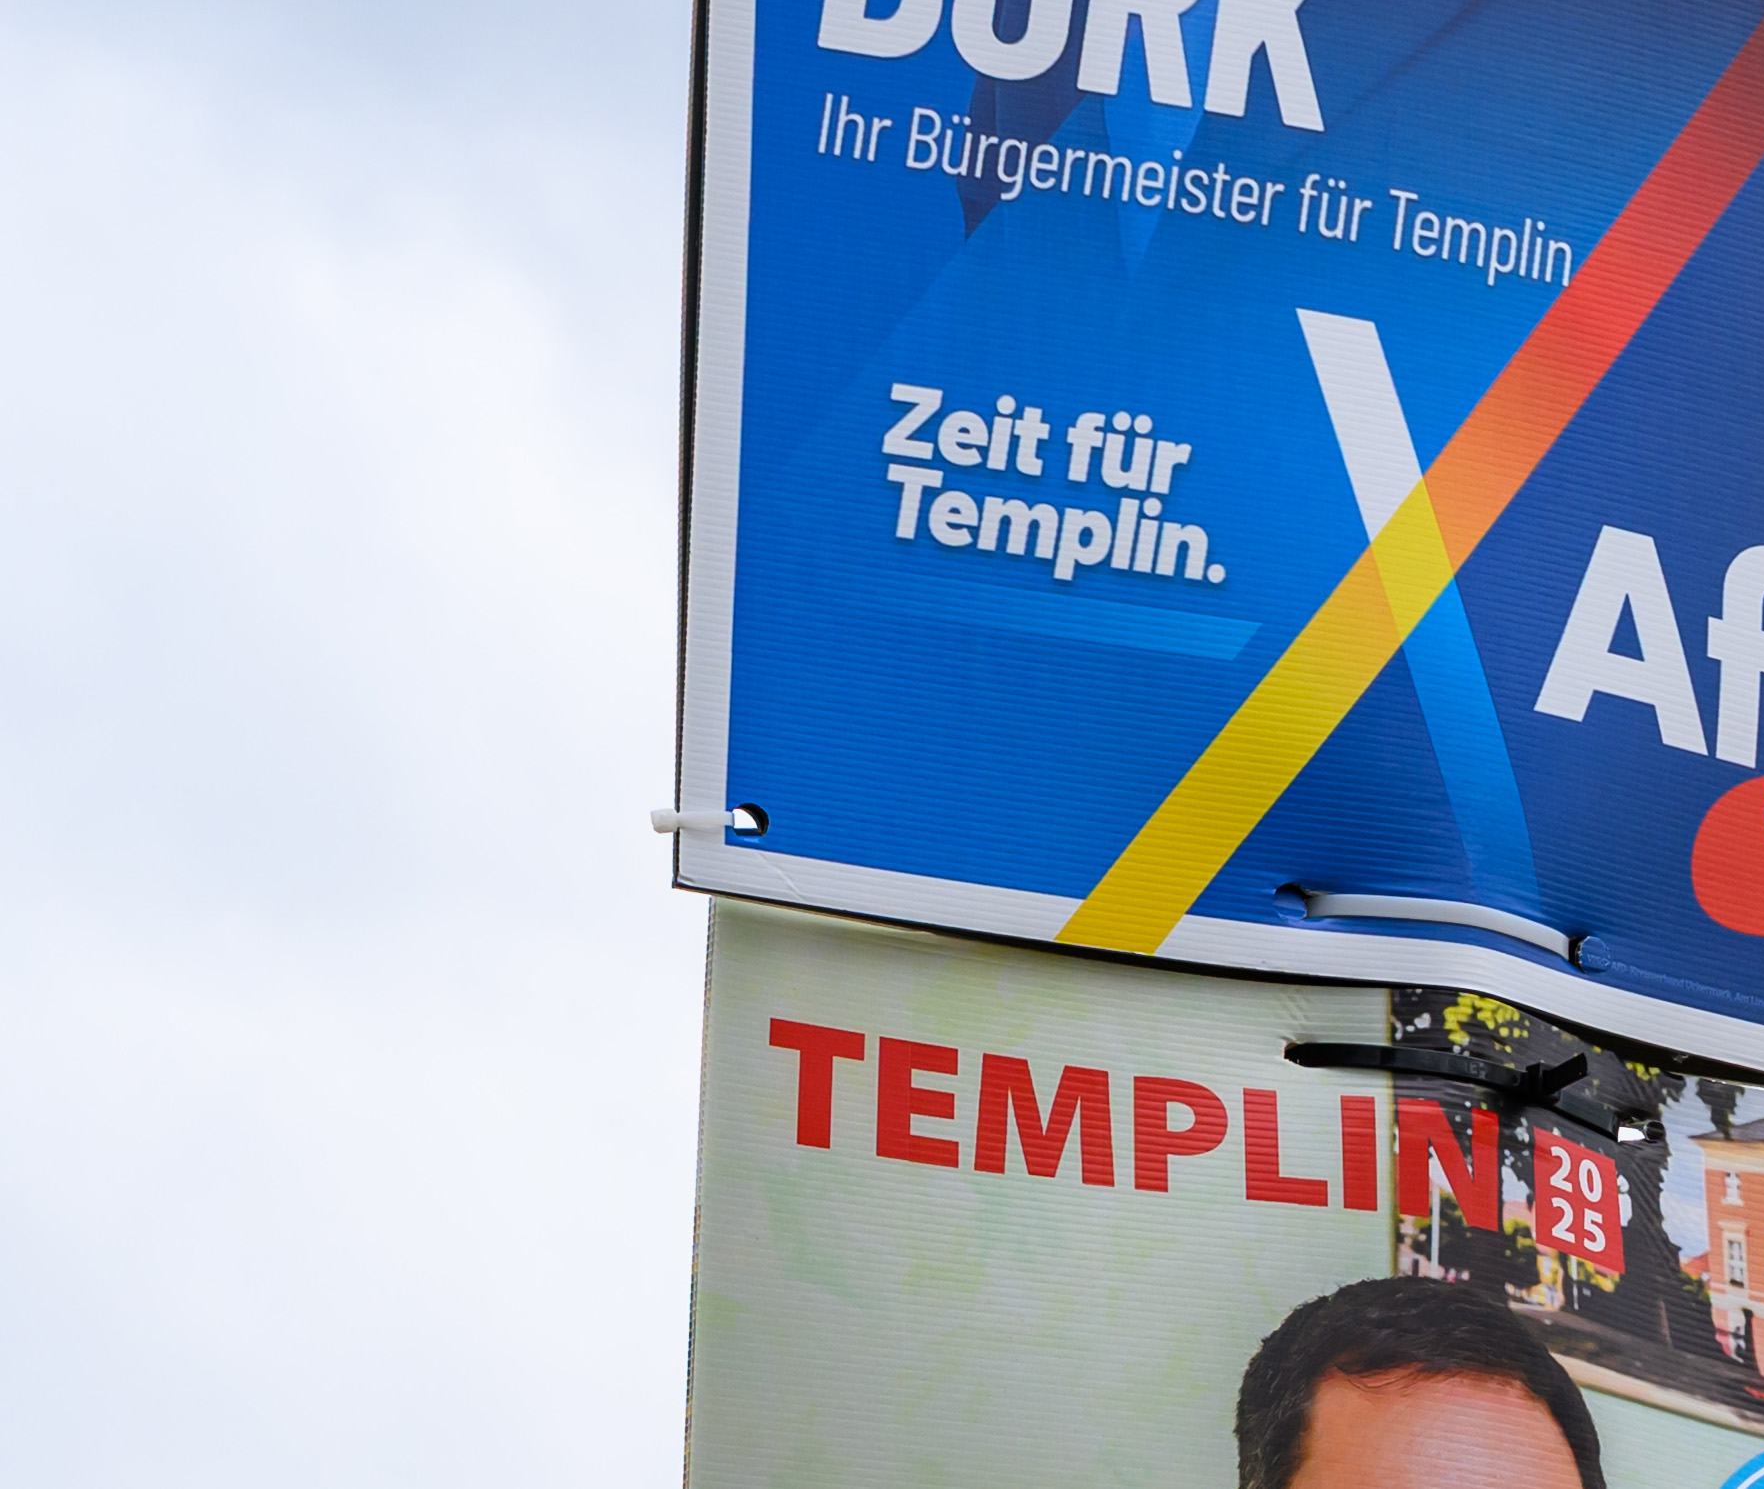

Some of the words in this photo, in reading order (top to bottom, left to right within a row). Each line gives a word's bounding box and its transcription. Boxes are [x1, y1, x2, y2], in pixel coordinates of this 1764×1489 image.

[819, 93, 892, 161] Ihr
[906, 107, 1285, 225] Bürgermeister
[1299, 173, 1372, 241] für
[1389, 188, 1572, 288] Templin
[882, 383, 1050, 476] Zeit
[1067, 411, 1192, 494] für
[887, 463, 1225, 583] Templin.
[769, 1017, 1500, 1232] TEMPLIN
[1549, 1145, 1603, 1203] 20
[1551, 1197, 1606, 1253] 25
